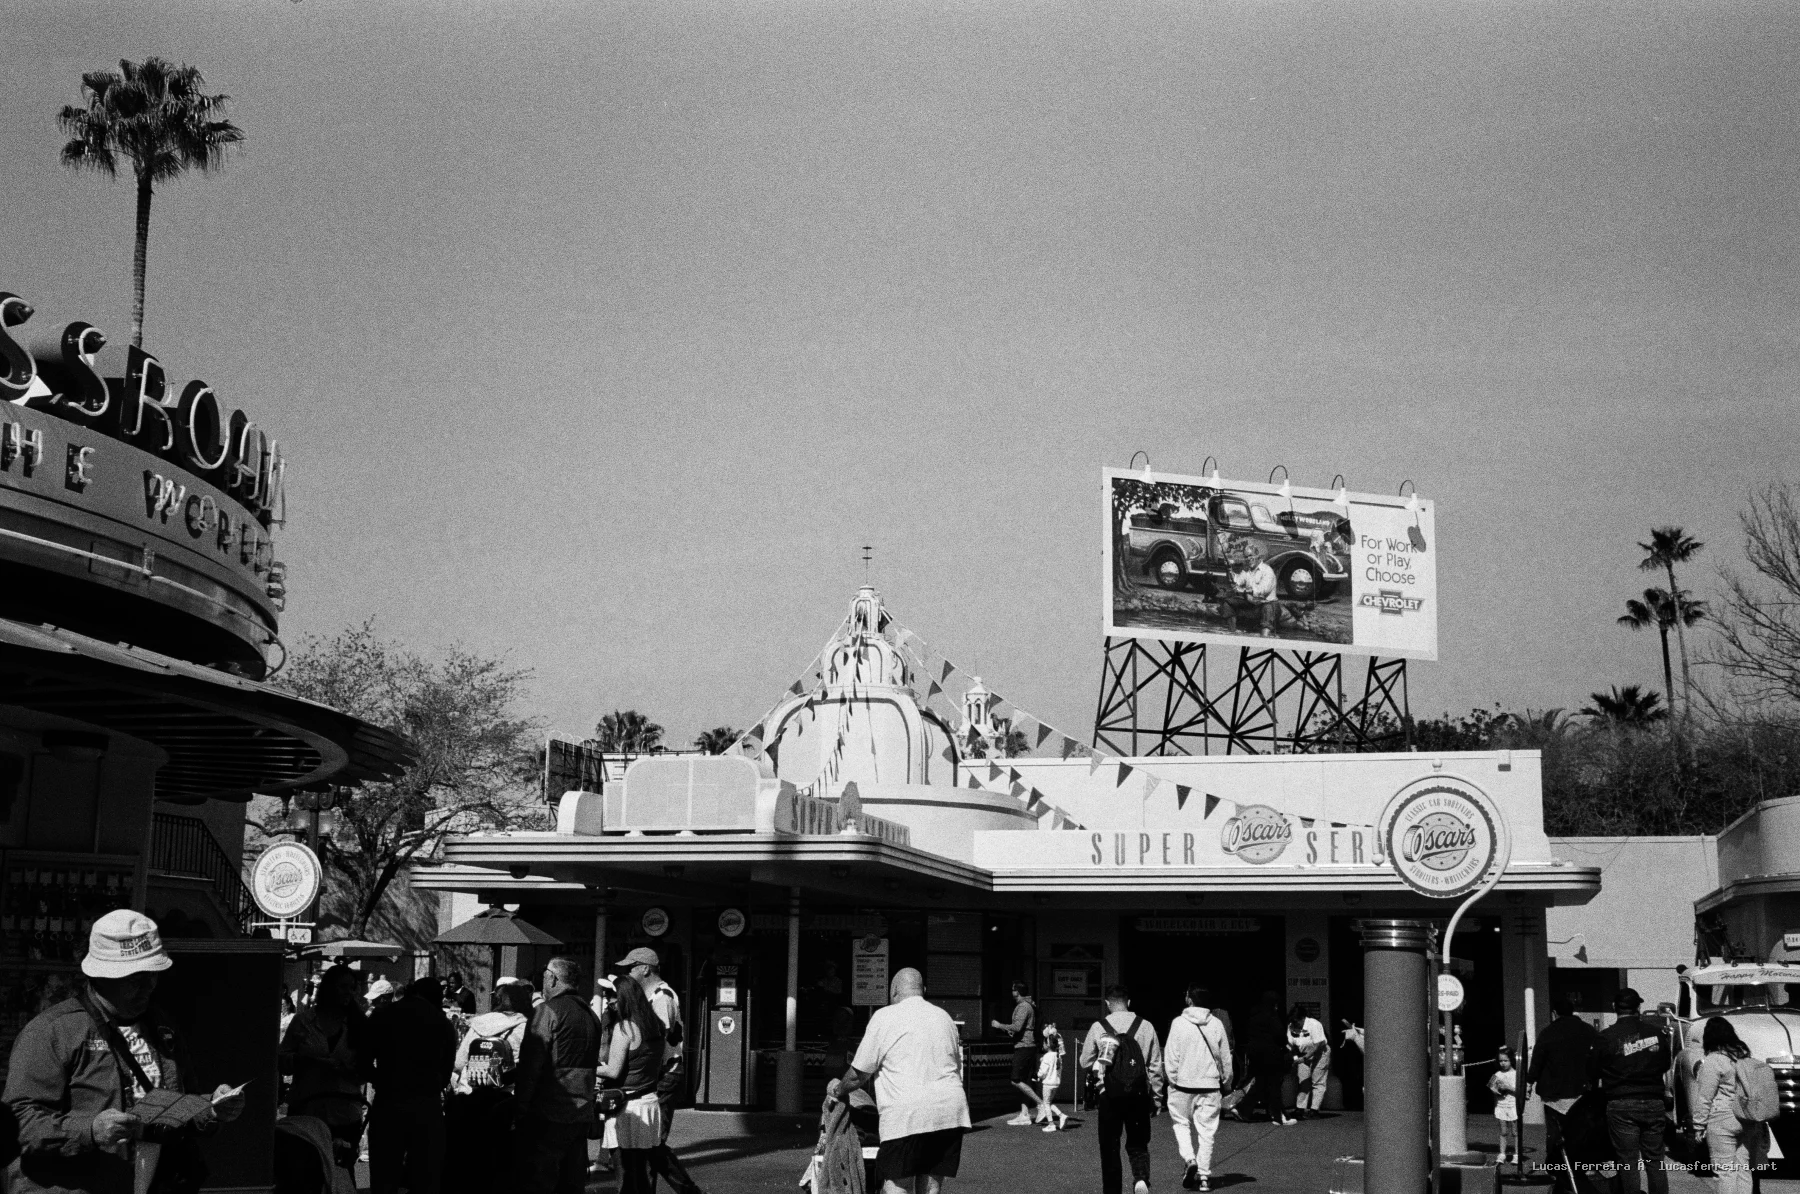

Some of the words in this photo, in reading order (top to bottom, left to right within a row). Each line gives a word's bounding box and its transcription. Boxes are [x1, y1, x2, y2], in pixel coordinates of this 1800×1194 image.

[1361, 534, 1382, 550] For
[1386, 537, 1418, 554] Work
[1367, 553, 1382, 565] or
[1386, 552, 1412, 571] Play,
[1365, 566, 1416, 585] Choose
[1362, 595, 1420, 610] CHEVROLET
[1405, 802, 1427, 822] CLASSIC
[1221, 816, 1293, 855] Oscar's
[1402, 823, 1476, 863] Oscar's
[1091, 832, 1195, 866] SUPER
